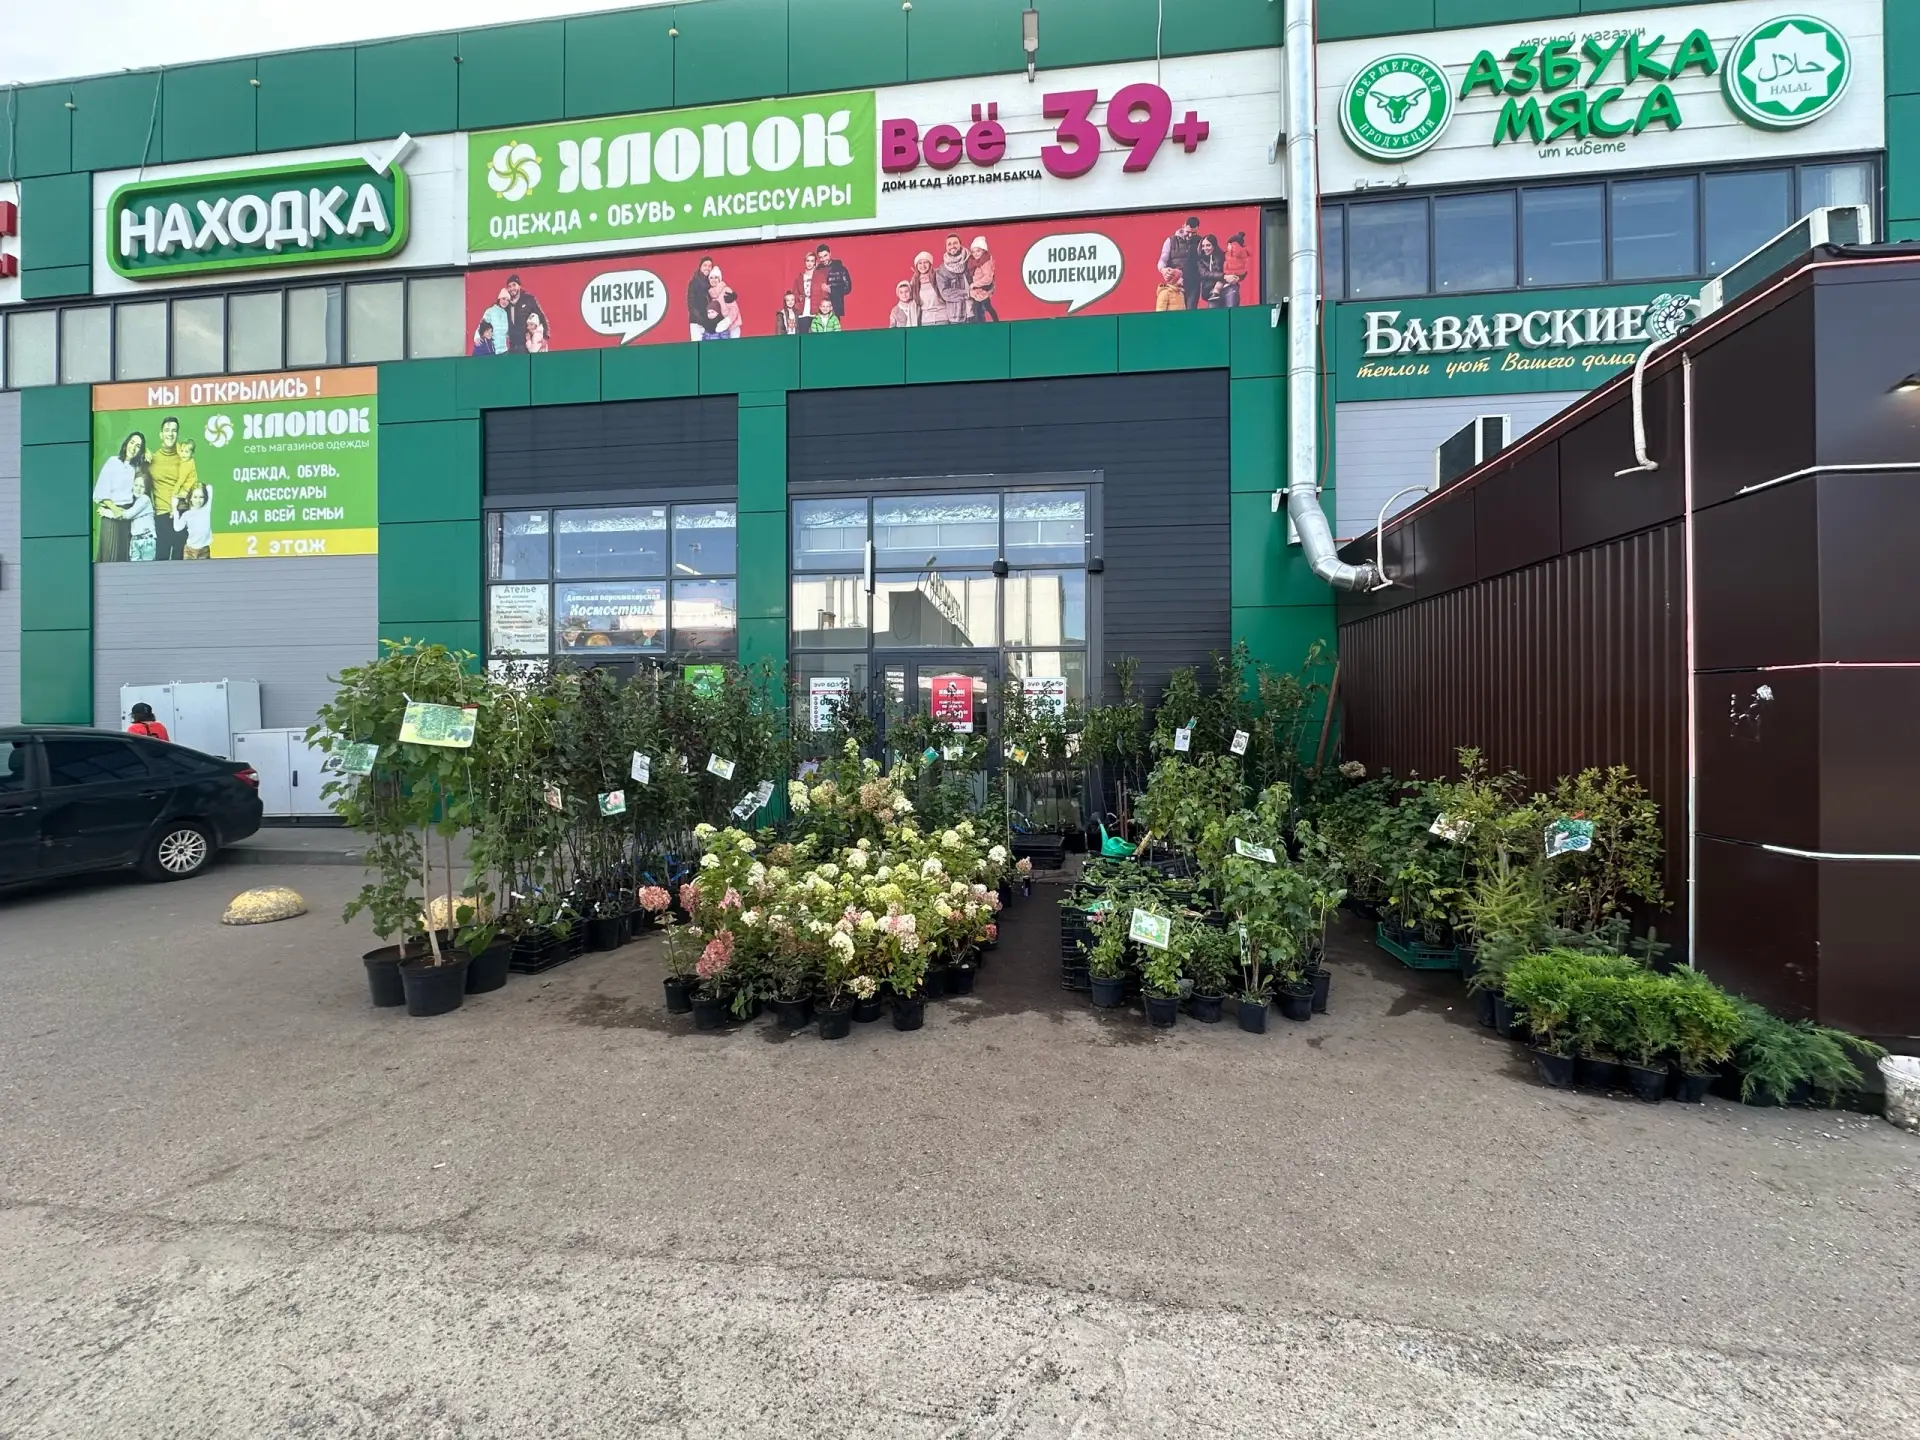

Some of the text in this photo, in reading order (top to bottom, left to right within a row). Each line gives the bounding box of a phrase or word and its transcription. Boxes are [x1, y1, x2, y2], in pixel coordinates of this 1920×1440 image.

[1459, 28, 1719, 101] АЗБУКА
[1757, 52, 1826, 83] حلال
[1355, 60, 1442, 97] ФЕРМЕРСКАЯ
[1770, 82, 1812, 96] HALAL
[1492, 83, 1682, 147] МЯСА
[881, 83, 1210, 179] Всё 39+
[1359, 118, 1436, 148] ПРОДУКЦИЯ
[556, 109, 855, 194] ХЛОПОК
[1538, 140, 1627, 159] ит кибете
[881, 179, 907, 193] ДОМ
[908, 178, 918, 190] И
[919, 176, 942, 190] САД
[946, 172, 977, 187] ЙОРТ
[1003, 168, 1043, 183] БАКЧА
[120, 182, 390, 259] НАХОДКА
[489, 183, 852, 240] ОДЕЖДА ОБУВЬ АКСЕССУАРЫ
[1047, 244, 1098, 263] НОВАЯ
[1027, 264, 1118, 286] КОЛЛЕКЦИЯ
[590, 279, 655, 304] НИЗКИЕ
[600, 302, 648, 327] ЦЕНЫ
[1362, 304, 1651, 358] БАВАРСКИЕ
[1446, 356, 1491, 379] уют
[1501, 352, 1576, 372] Вашего
[1581, 352, 1636, 374] дома
[148, 386, 180, 407] МЫ
[190, 378, 308, 404] ОТКРЫЛИСЬ
[242, 407, 371, 440] ХЛОПОК
[244, 439, 370, 455] сеть магазинов одежды
[246, 485, 327, 502] АКСЕССУАРЫ
[229, 504, 344, 526] ДЛЯ ВСЕЙ СЕМЬИ
[246, 535, 327, 555] 2 этаж
[503, 585, 537, 594] Ателье
